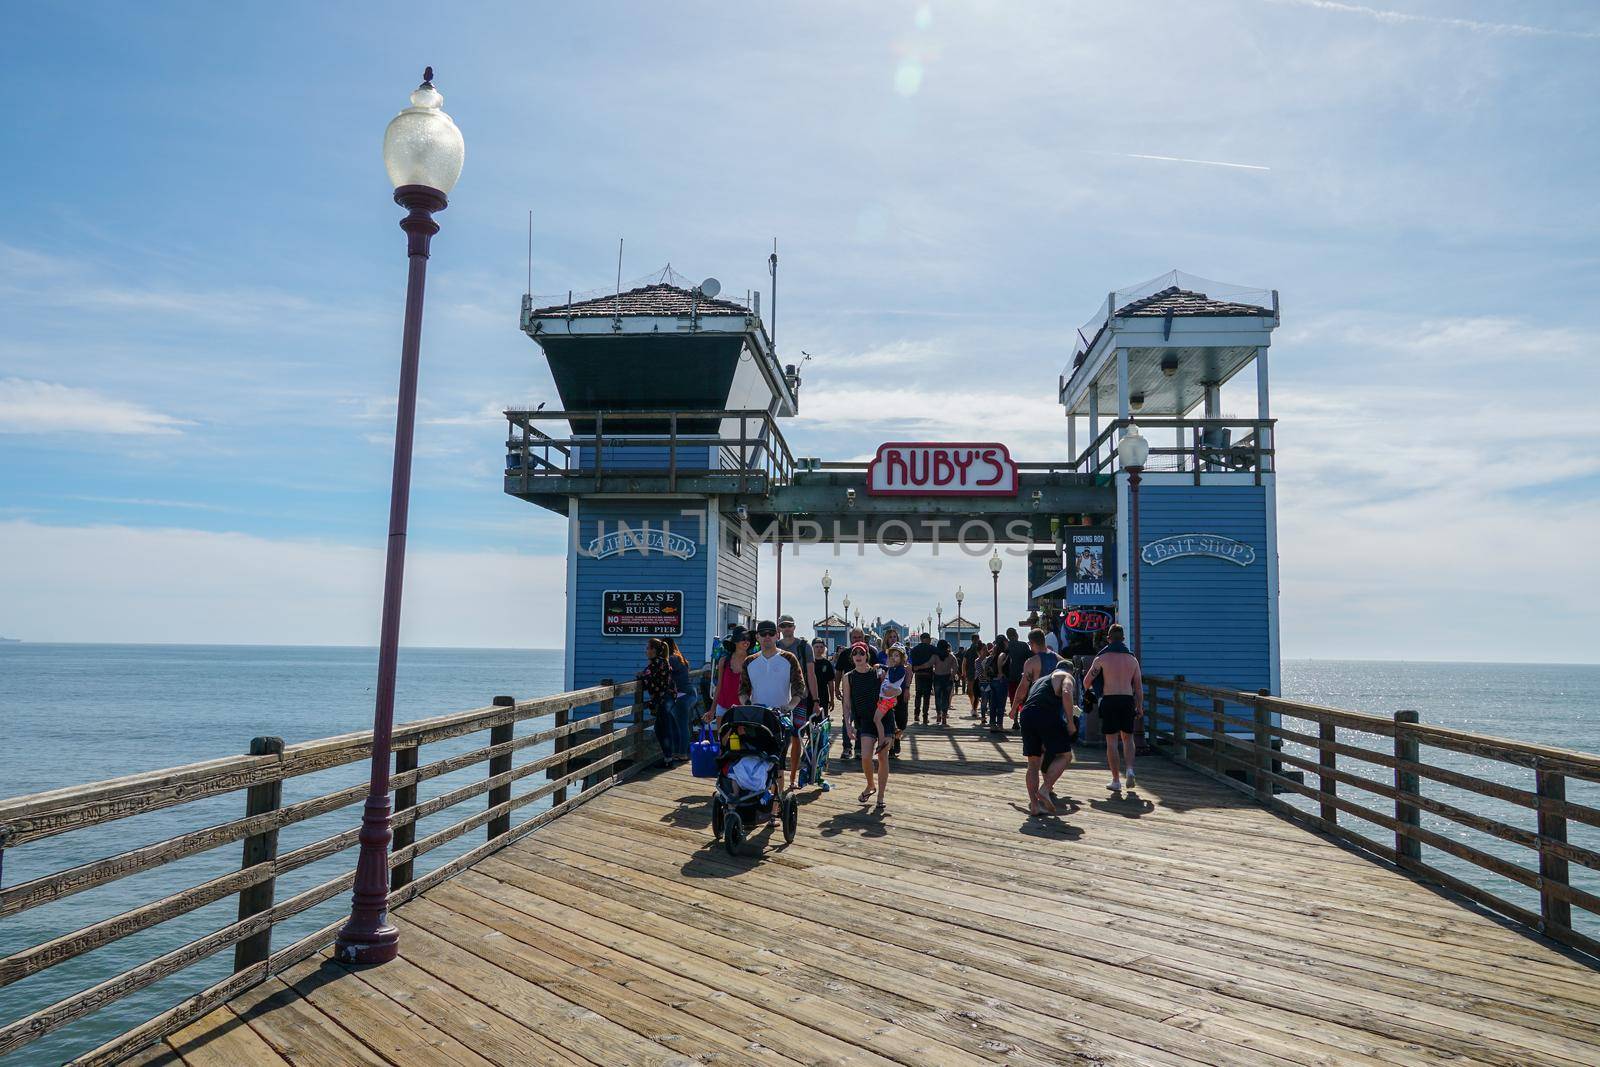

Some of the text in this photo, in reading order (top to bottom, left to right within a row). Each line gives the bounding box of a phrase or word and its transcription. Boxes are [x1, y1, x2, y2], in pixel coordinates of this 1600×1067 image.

[886, 449, 1004, 486] RUBY'S
[599, 533, 688, 554] LIFEGUARD
[1072, 535, 1093, 543] FISHING
[1154, 538, 1243, 558] BAIT SHOP
[1073, 582, 1105, 595] RENTAL
[611, 593, 675, 602] PLEASE
[625, 606, 661, 614] RULES
[607, 615, 620, 623] NO
[1065, 610, 1108, 632] OPEN
[608, 626, 624, 634] ON
[654, 626, 677, 634] PIER
